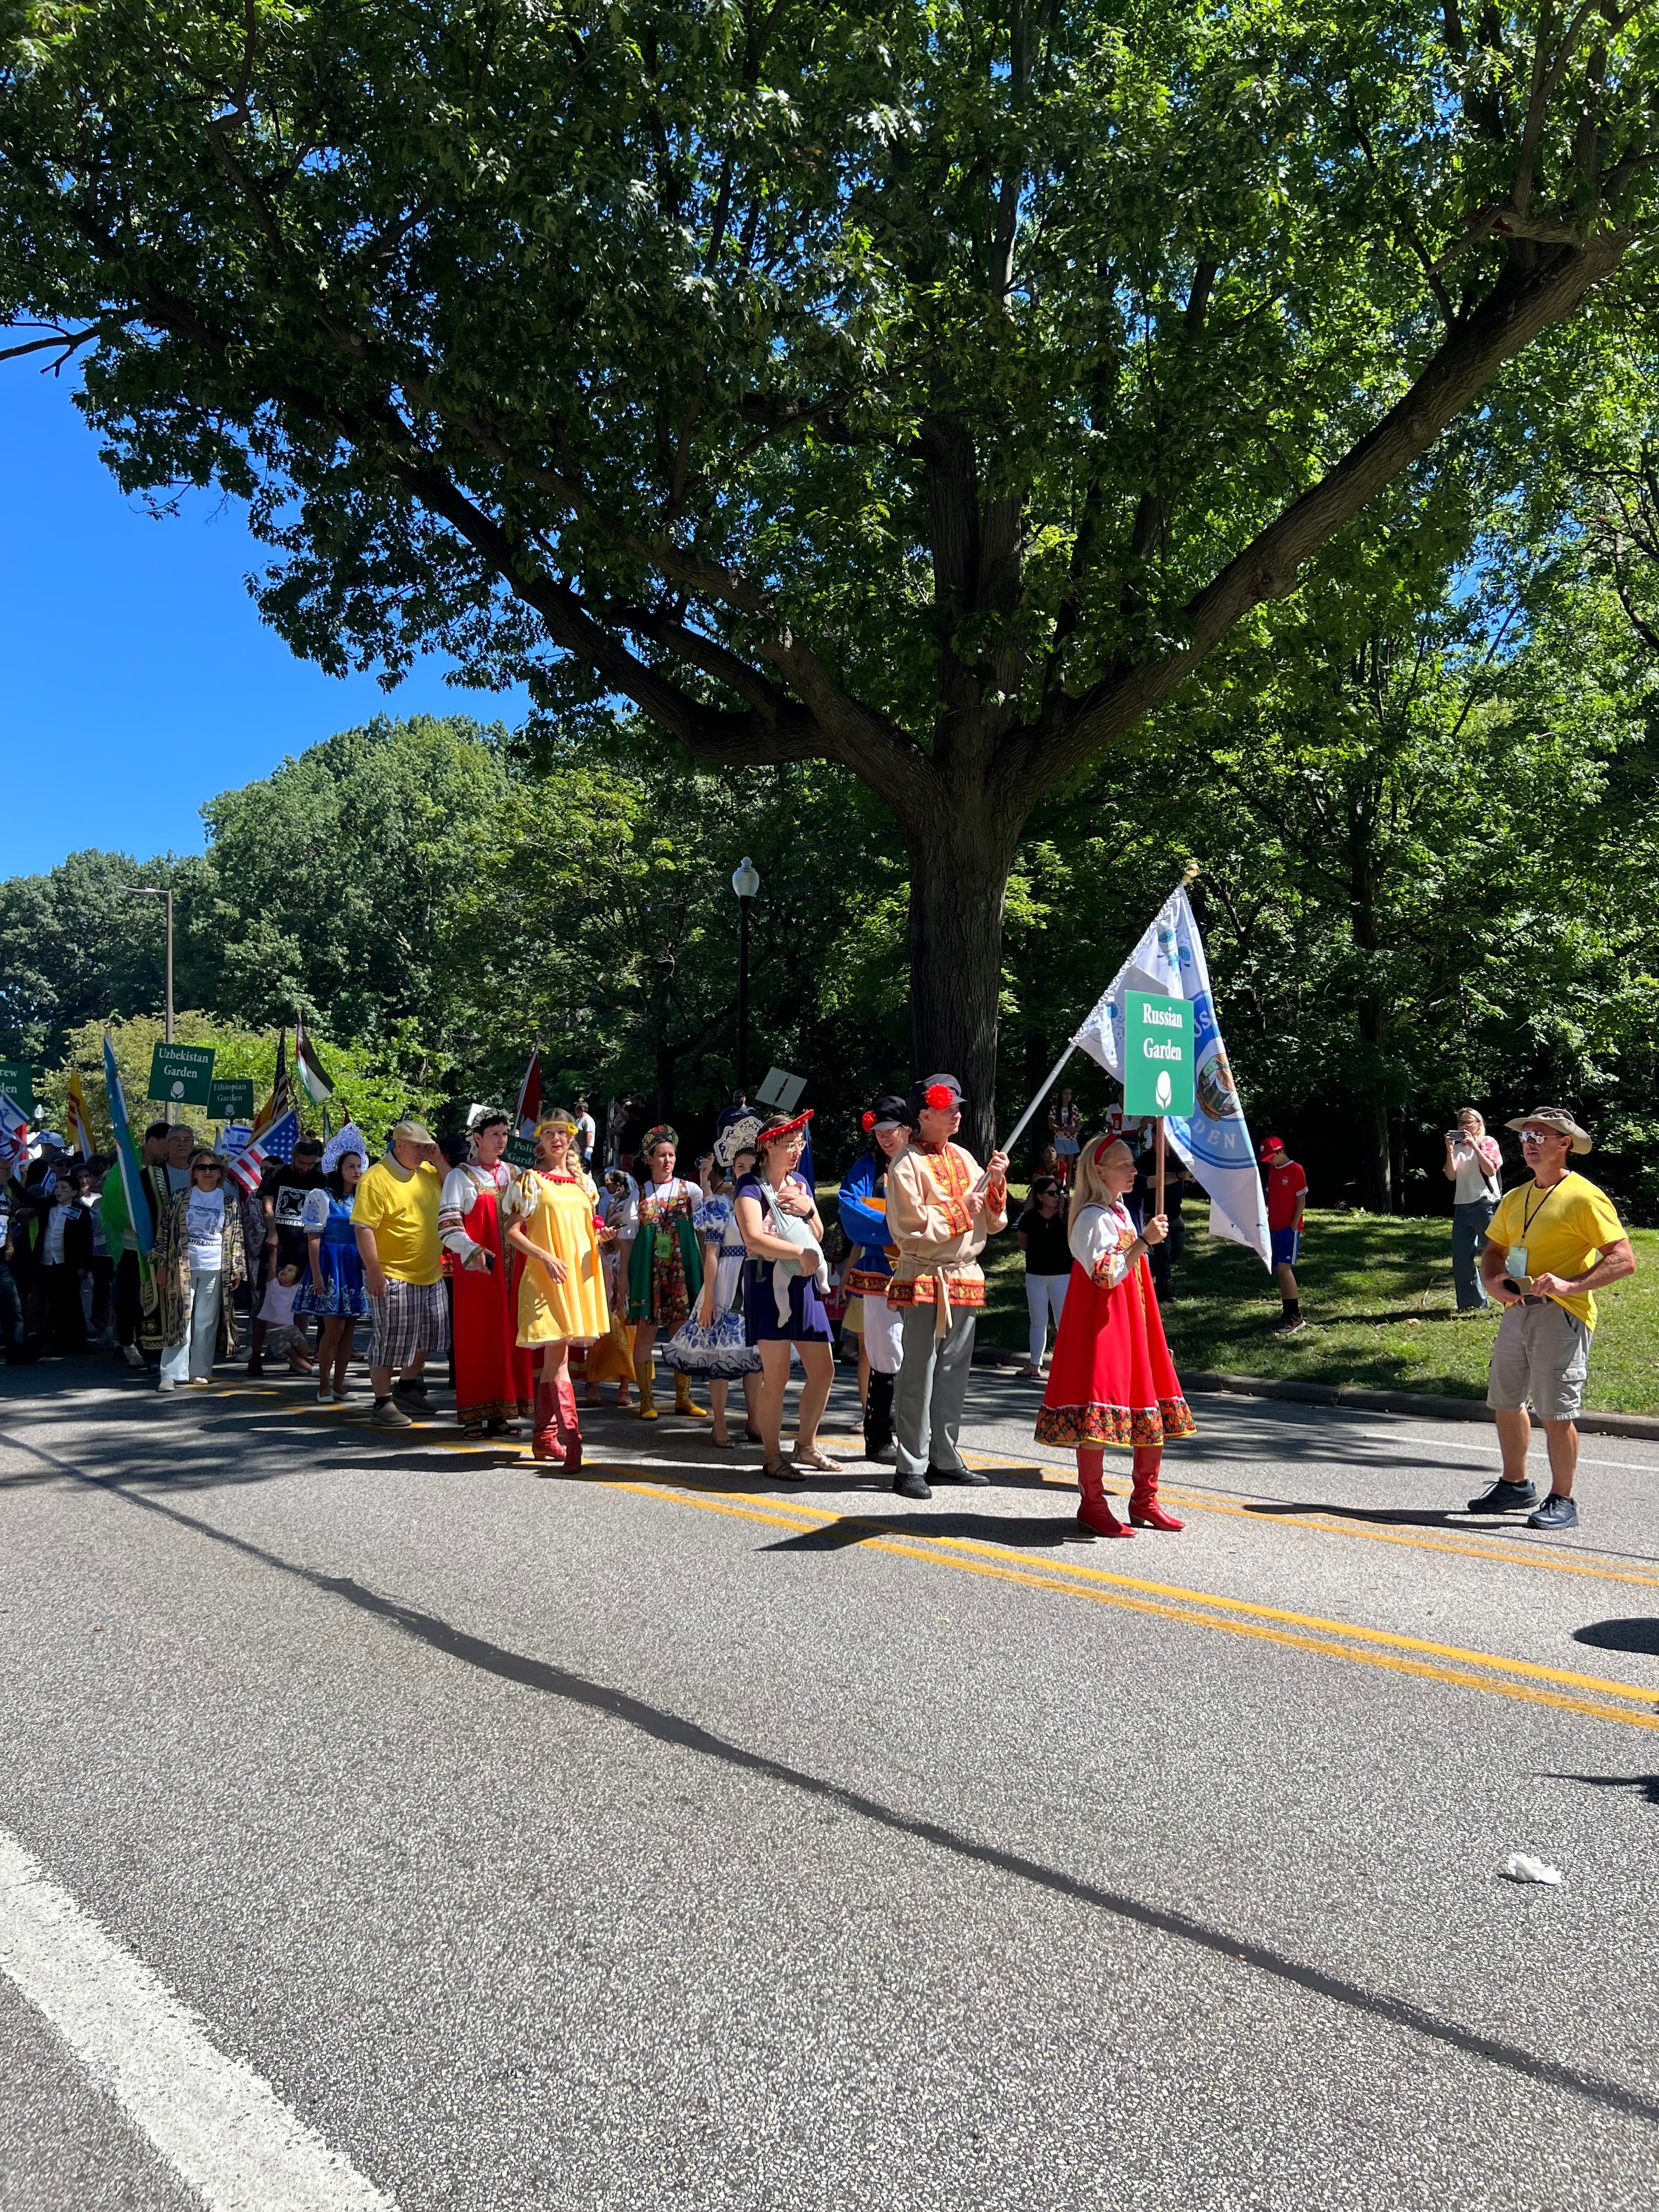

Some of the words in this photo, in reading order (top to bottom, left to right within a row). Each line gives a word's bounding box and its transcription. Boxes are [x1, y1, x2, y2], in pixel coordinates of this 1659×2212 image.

[1142, 1003, 1183, 1028] Russian
[159, 1048, 208, 1063] Uzbekistan
[1143, 1037, 1182, 1061] Garden
[163, 1065, 198, 1079] Garden
[213, 1083, 246, 1092] Ethiopian
[217, 1093, 242, 1102] Garden
